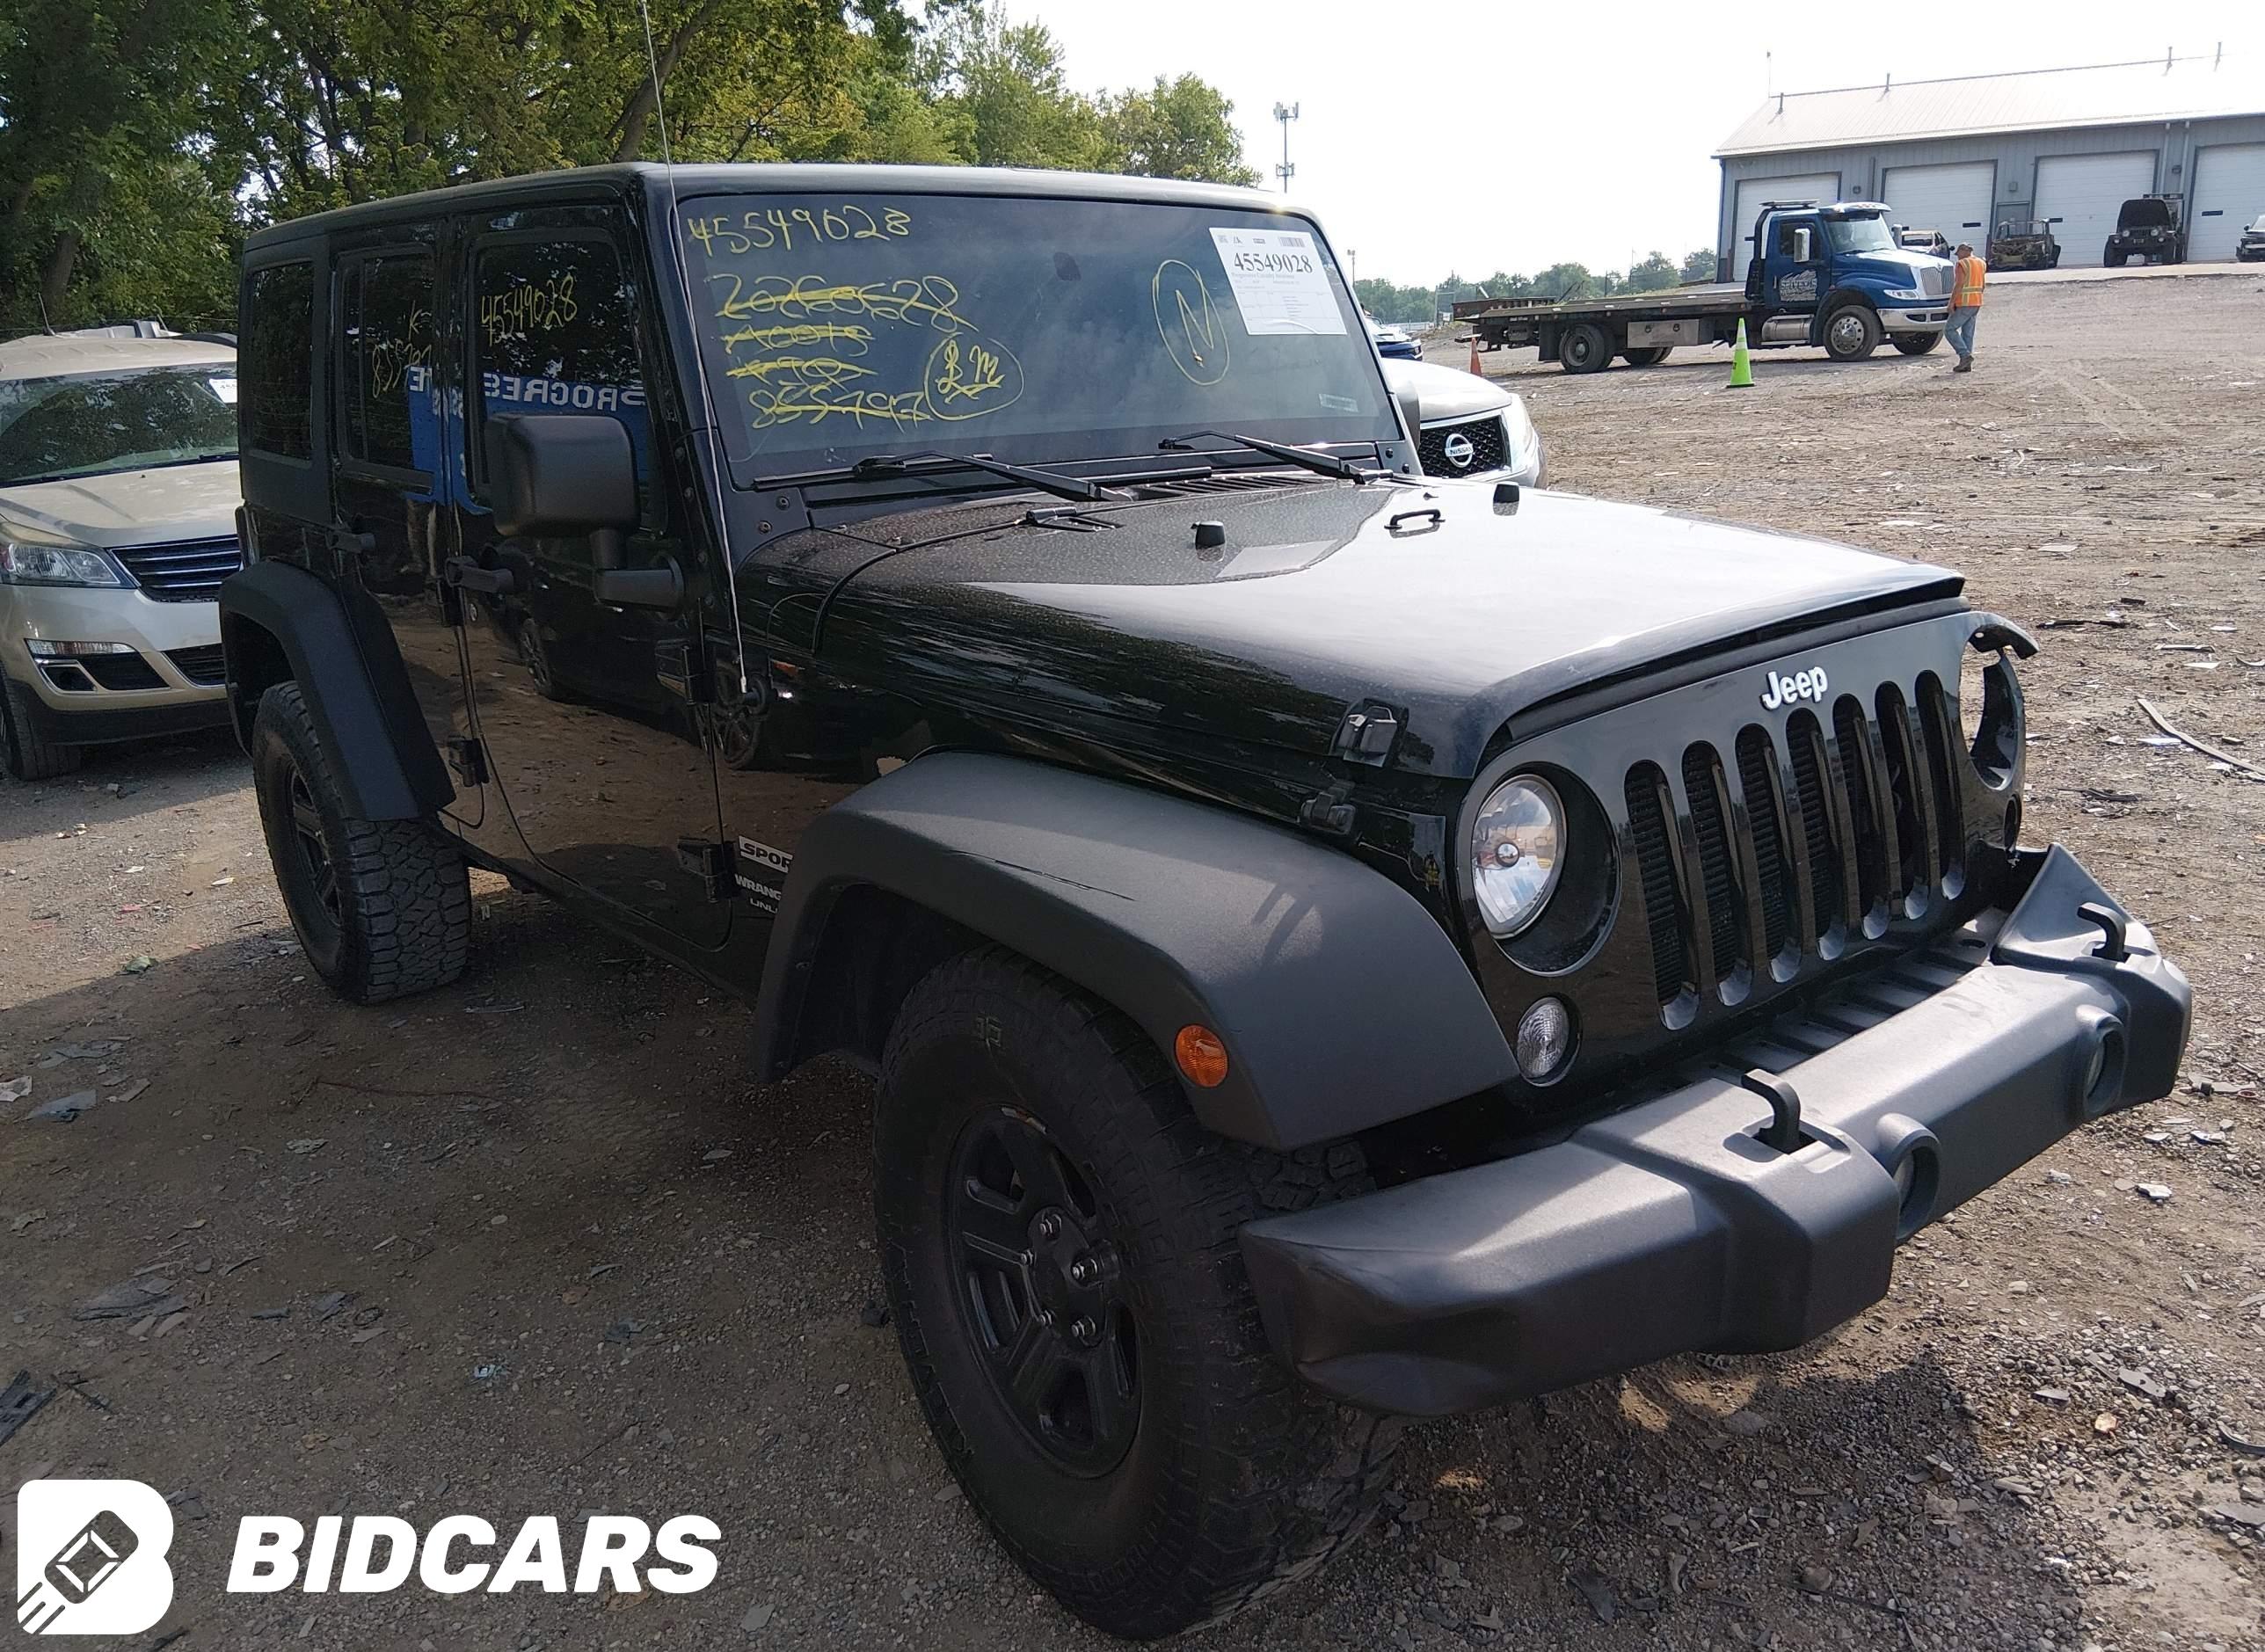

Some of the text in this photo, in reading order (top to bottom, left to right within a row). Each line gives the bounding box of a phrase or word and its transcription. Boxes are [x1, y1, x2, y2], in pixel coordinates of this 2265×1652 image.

[687, 205, 912, 258] 45549028
[1234, 252, 1313, 273] 45549028
[481, 273, 578, 347] 45549028
[1760, 666, 1829, 710] Jeep
[744, 841, 791, 869] SPOR
[734, 873, 782, 902] WRANG
